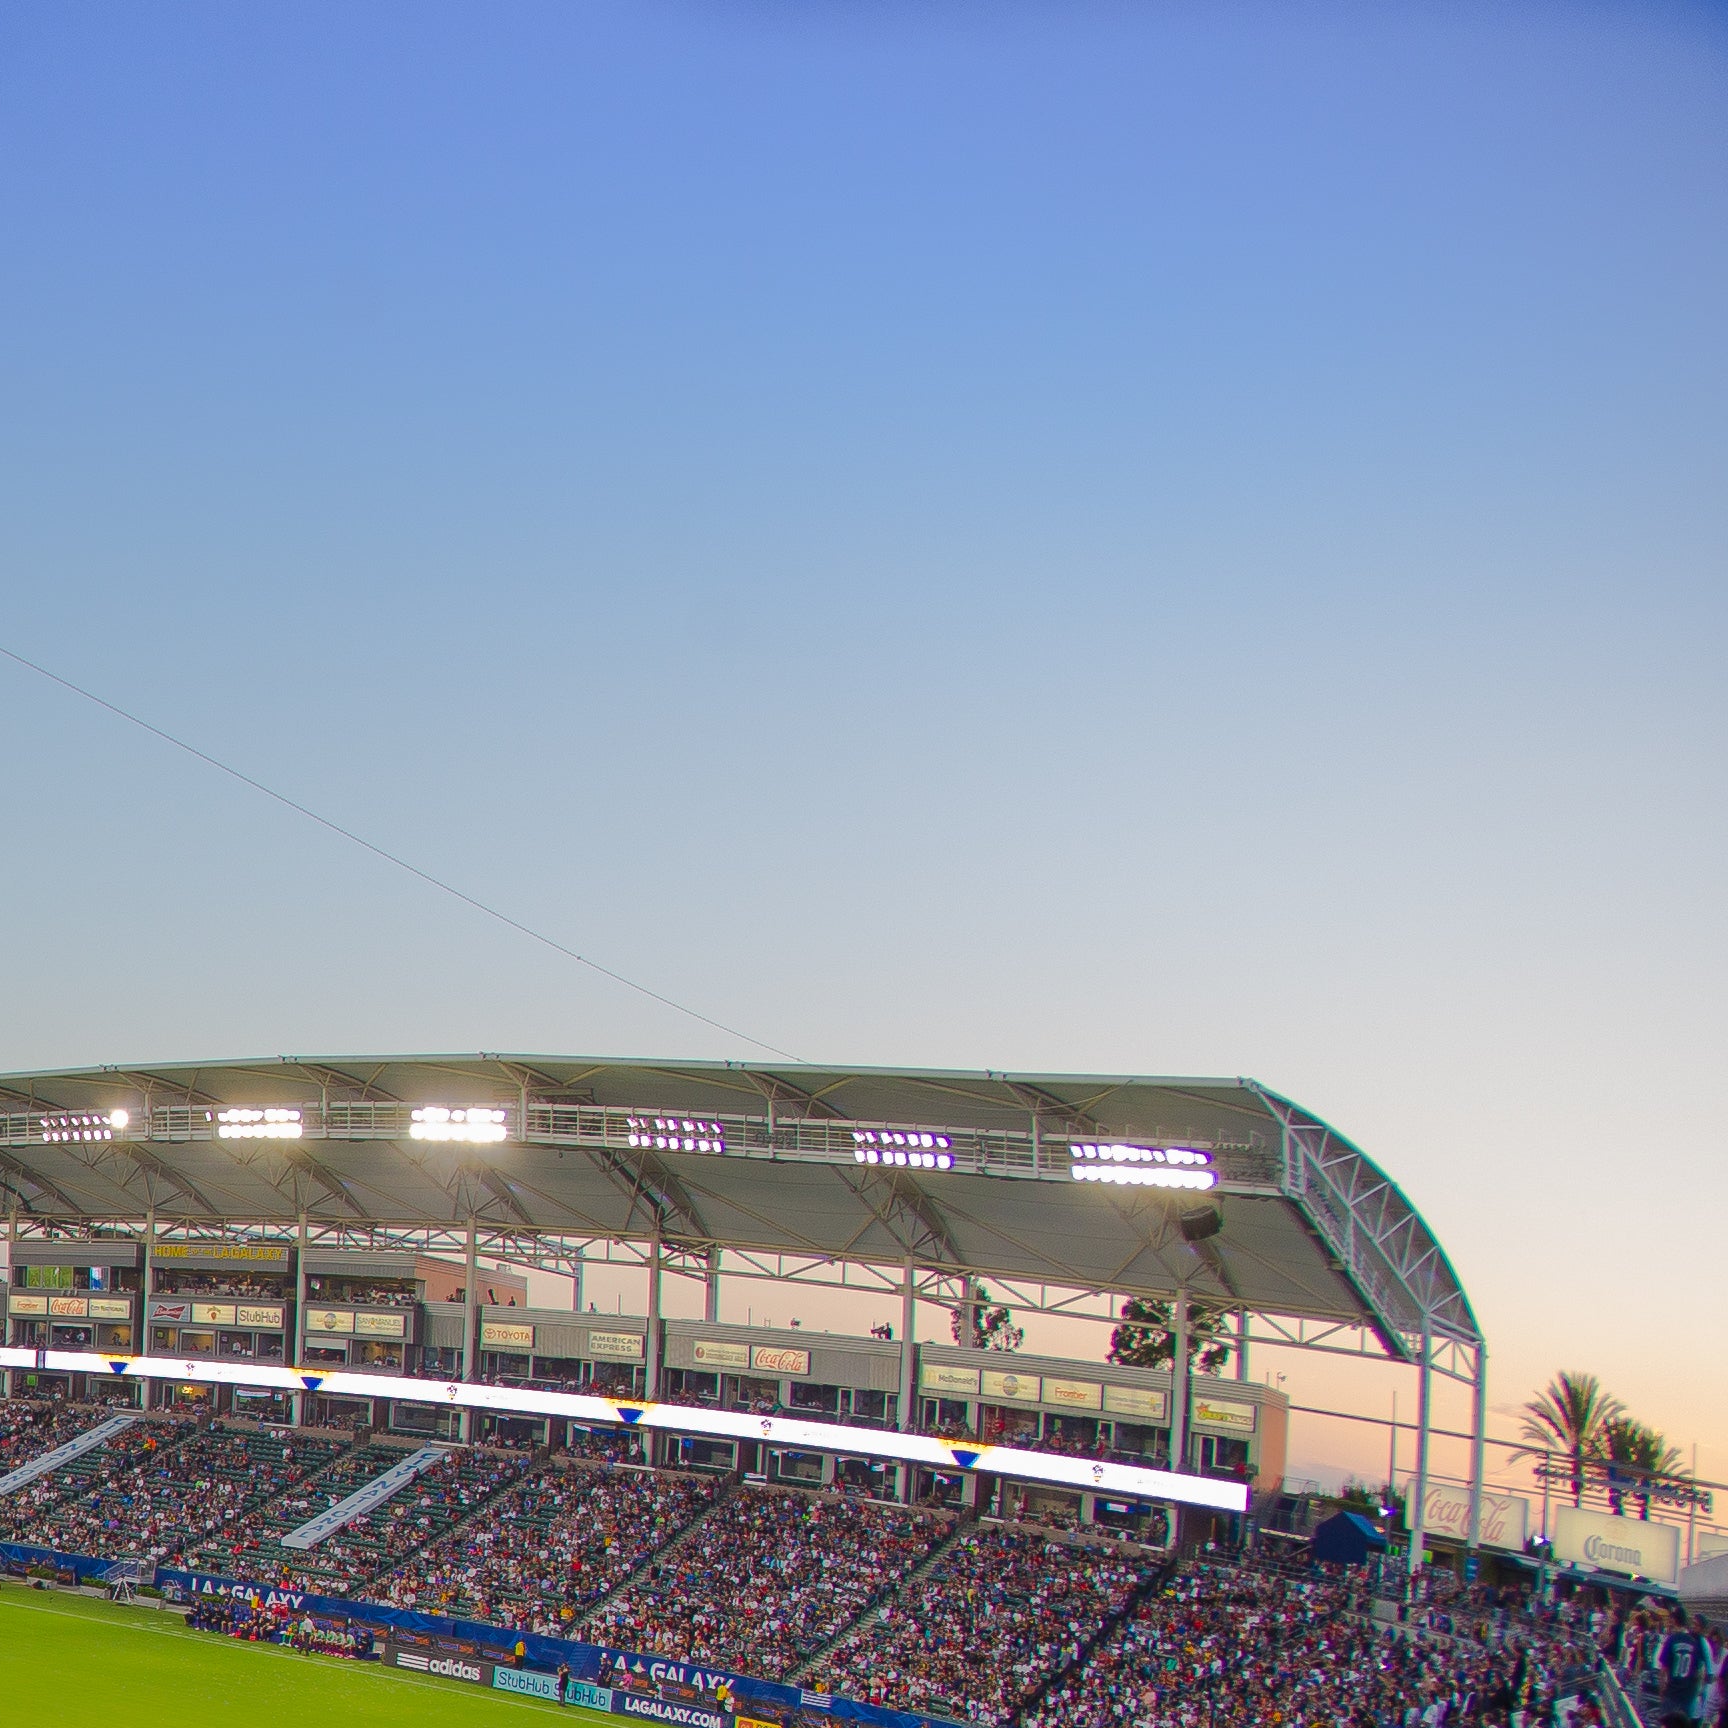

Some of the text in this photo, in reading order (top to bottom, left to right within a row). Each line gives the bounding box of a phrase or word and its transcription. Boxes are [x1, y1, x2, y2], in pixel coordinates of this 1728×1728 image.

[239, 1310, 280, 1323] StubHub
[497, 1330, 529, 1340] TOYOTA
[1584, 1535, 1642, 1567] Corona
[429, 1658, 481, 1681] adidas
[498, 1671, 606, 1707] StubHub SubHub
